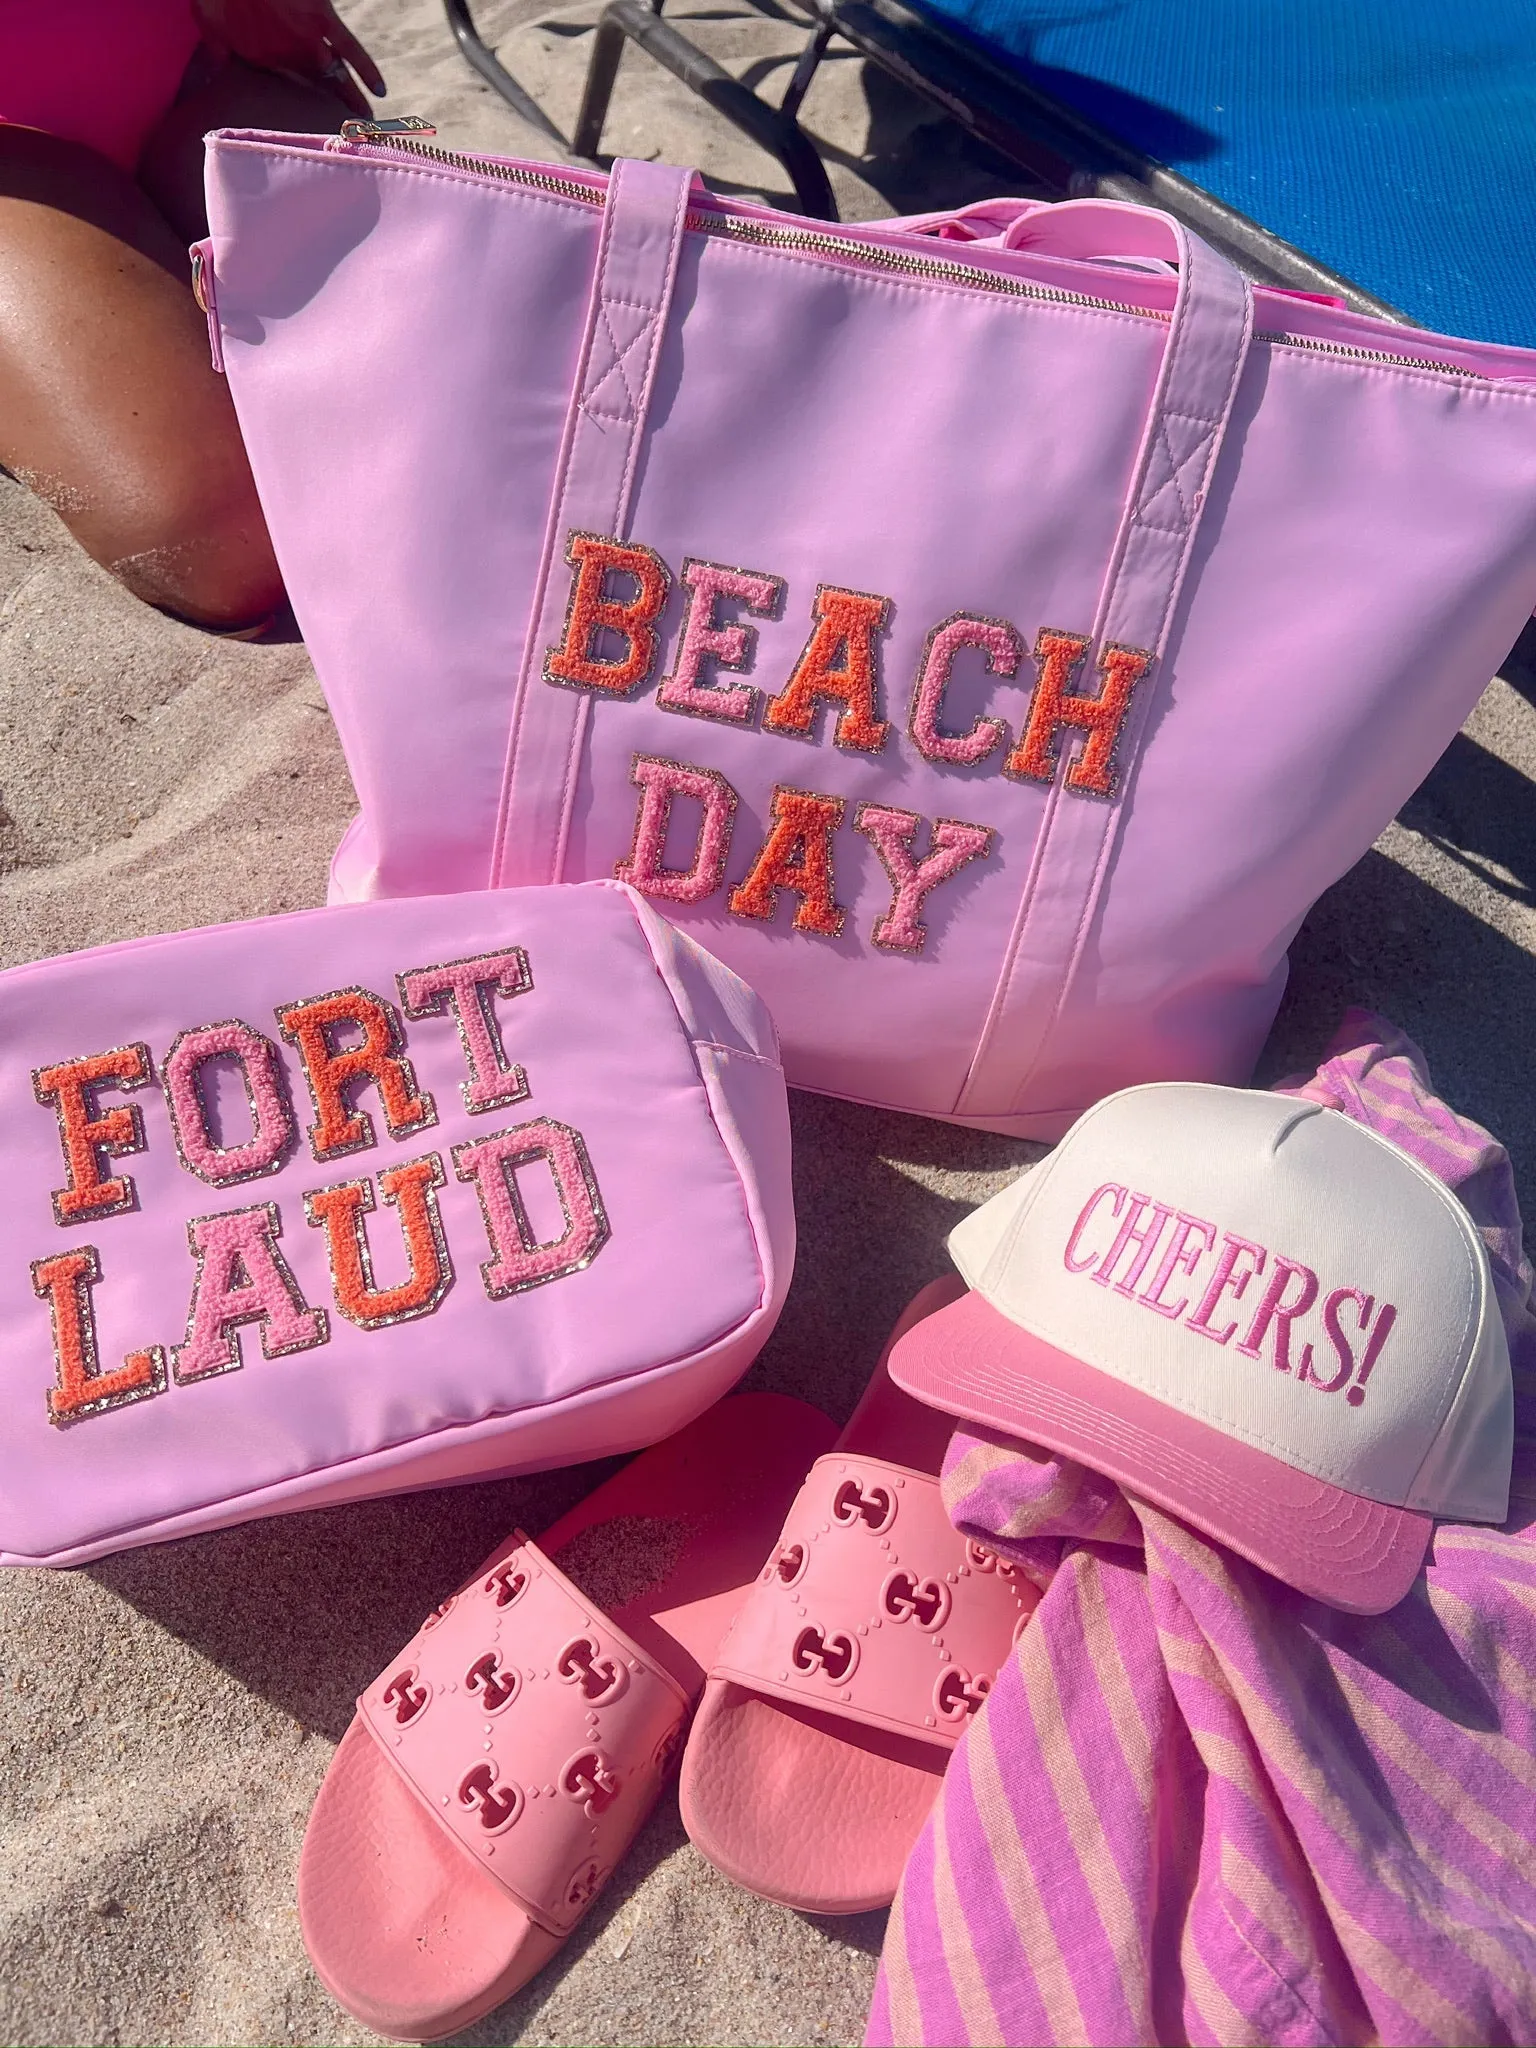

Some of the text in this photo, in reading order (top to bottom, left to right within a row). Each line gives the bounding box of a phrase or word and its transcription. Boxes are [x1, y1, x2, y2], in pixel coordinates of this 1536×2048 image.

[543, 528, 1156, 798] BEACH
[614, 752, 997, 955] DAY
[31, 945, 534, 1226] FORT
[29, 1116, 610, 1428] LAUD
[1063, 1182, 1398, 1408] CHEERS!
